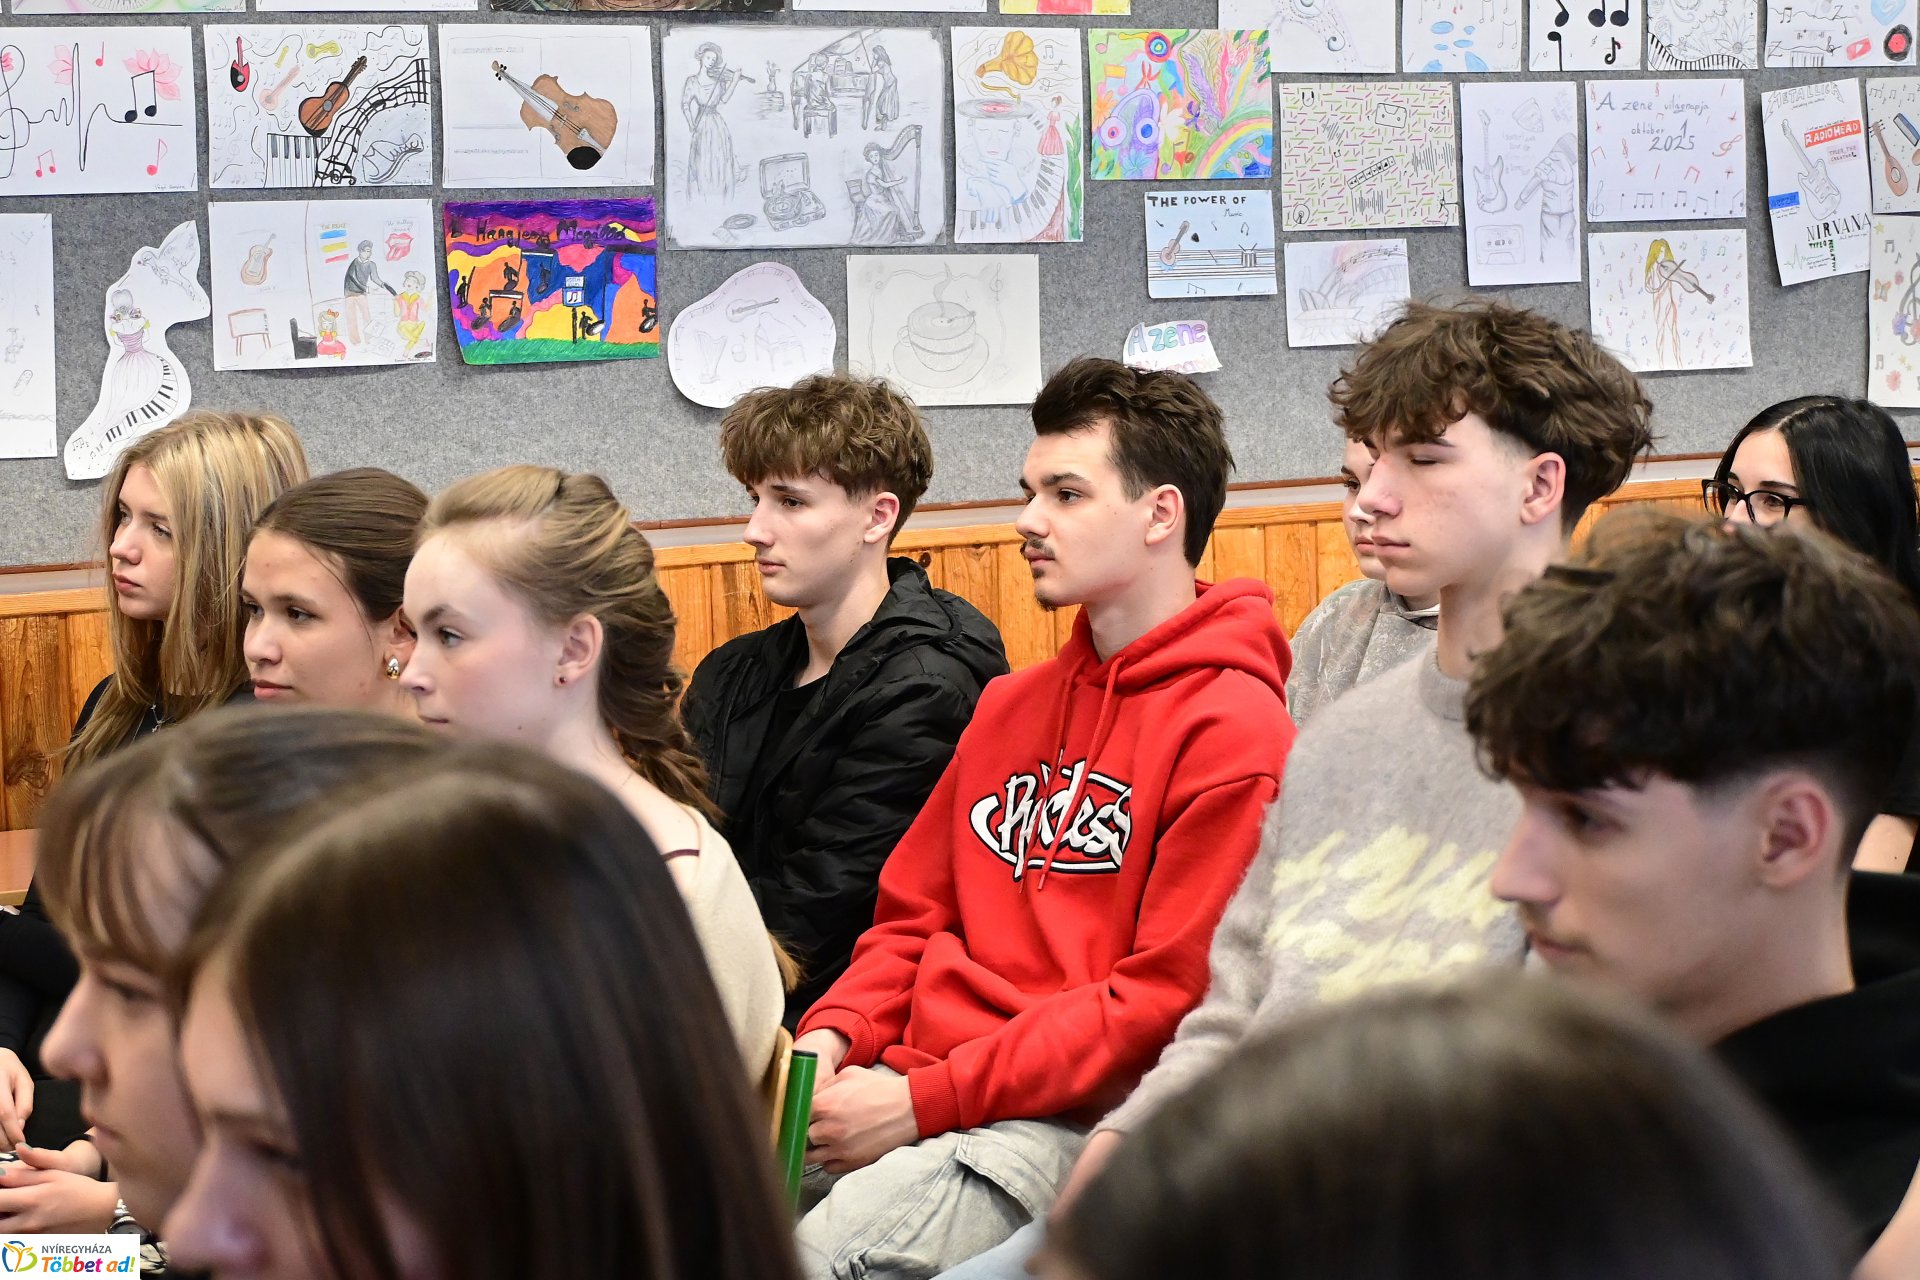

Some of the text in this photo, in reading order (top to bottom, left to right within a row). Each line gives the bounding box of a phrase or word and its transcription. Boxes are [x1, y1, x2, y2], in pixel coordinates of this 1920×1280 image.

[1596, 91, 1616, 111] A
[1621, 100, 1653, 111] zene
[1764, 82, 1844, 124] METALLICA
[1631, 119, 1688, 138] október 1
[1804, 122, 1859, 144] RADIOHEAD
[1649, 135, 1695, 151] 2025
[1147, 196, 1247, 207] THE POWER OF
[1806, 212, 1871, 241] NIRVANA
[1128, 323, 1206, 357] A zene
